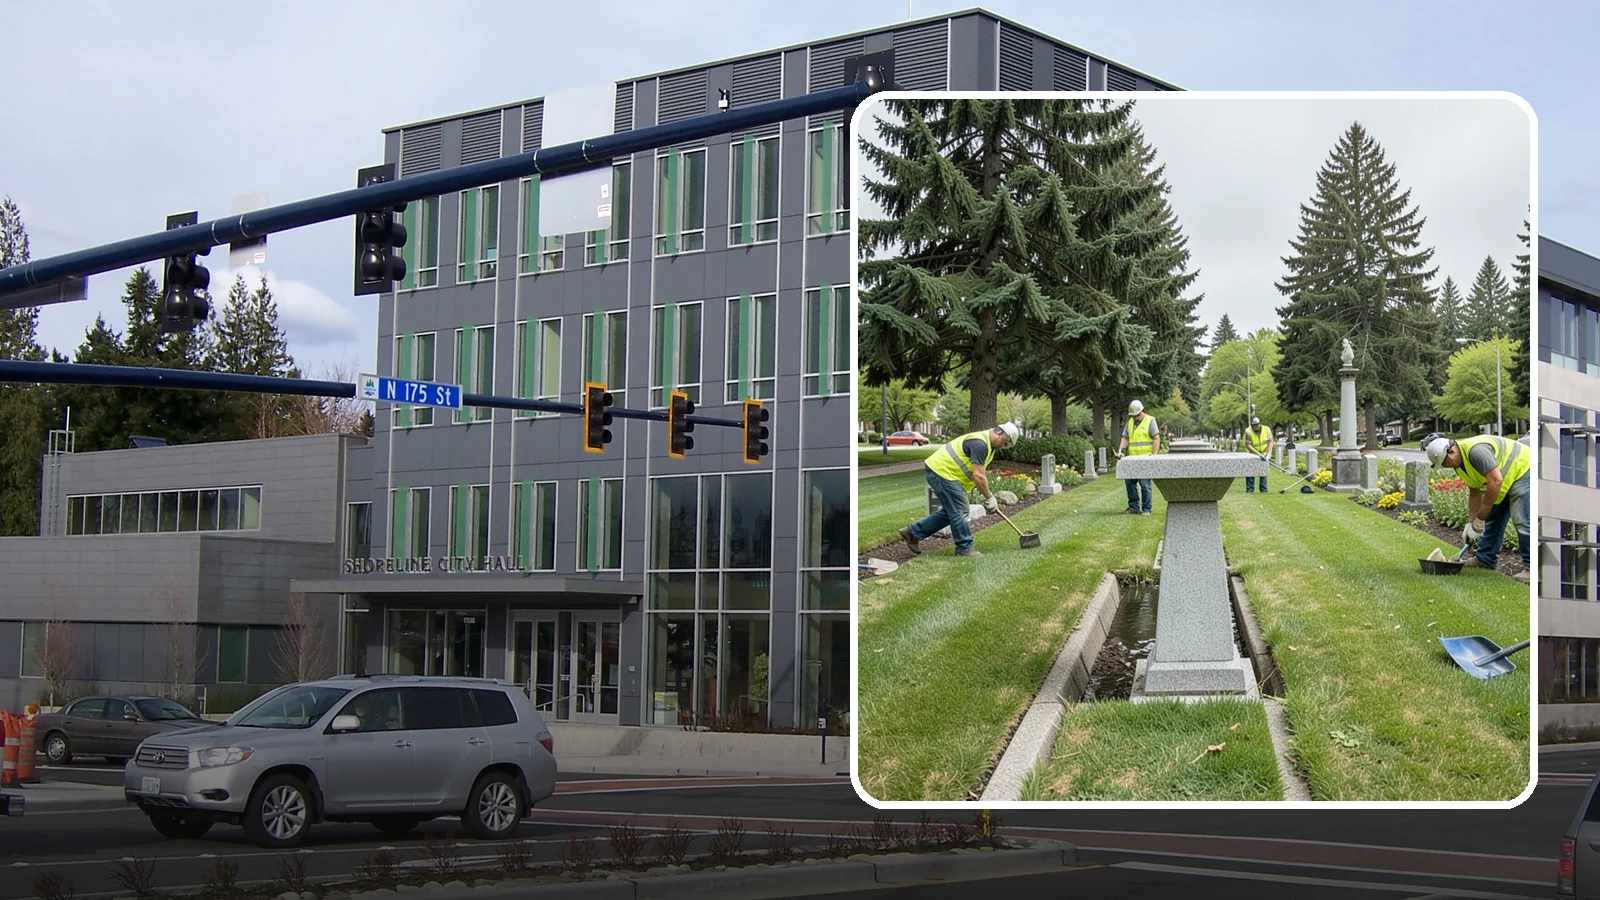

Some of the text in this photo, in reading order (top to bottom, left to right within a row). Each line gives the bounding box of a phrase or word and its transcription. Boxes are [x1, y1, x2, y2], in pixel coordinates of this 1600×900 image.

[387, 380, 452, 406] N 175 St
[344, 555, 525, 574] SHORELINE CITY HALL
